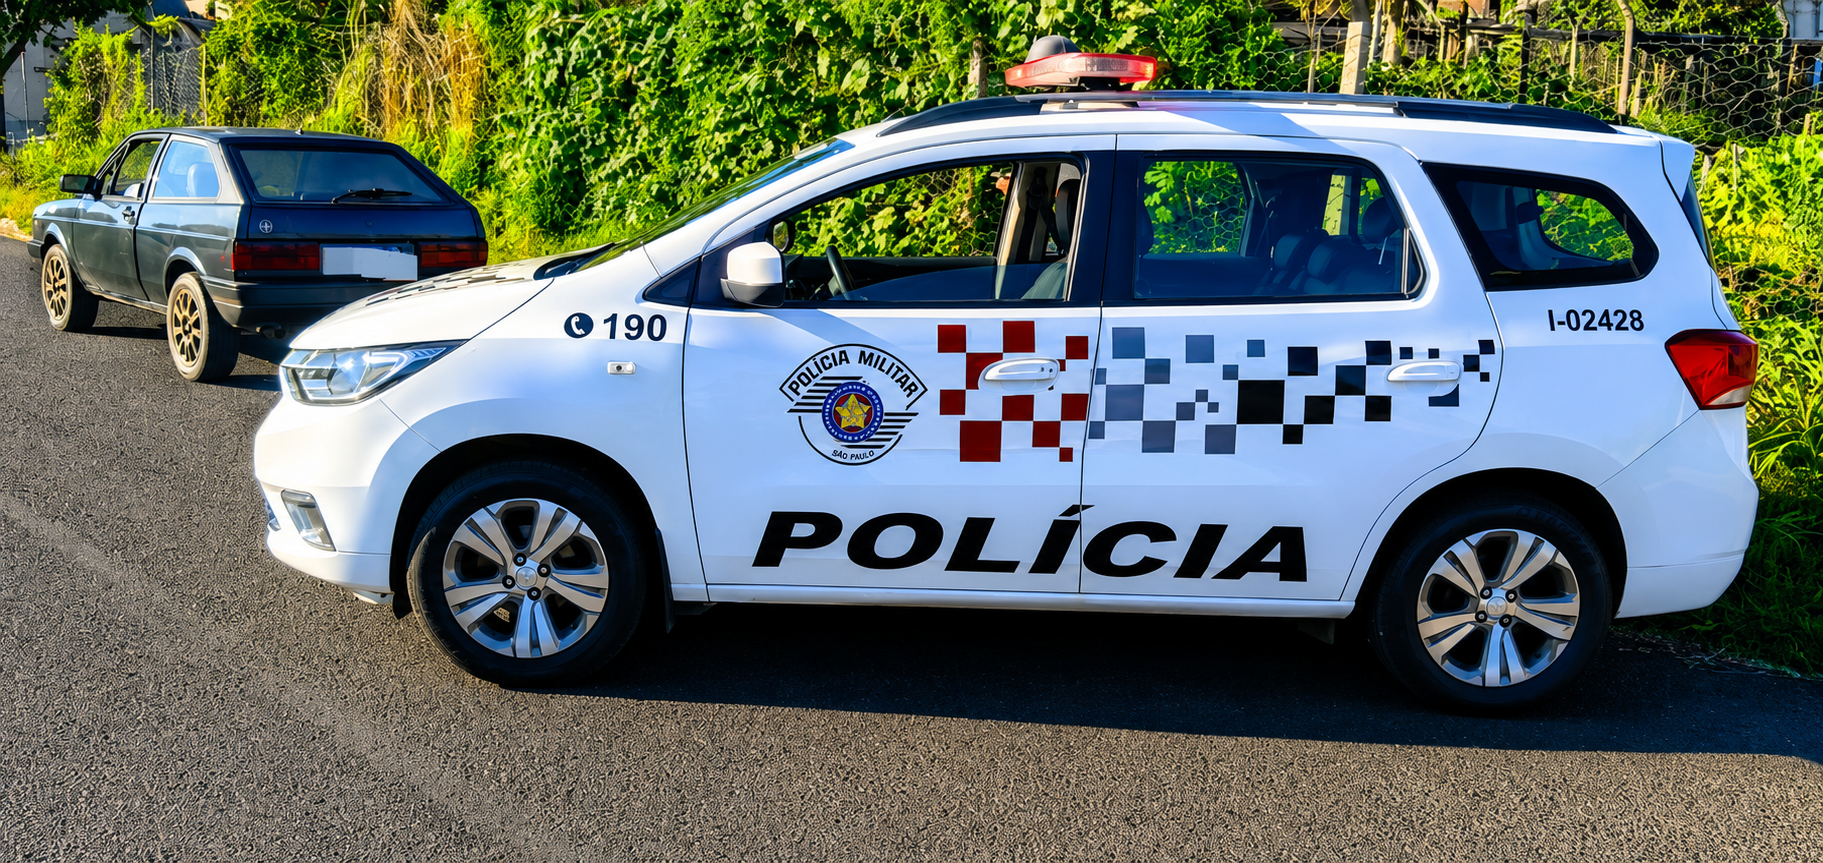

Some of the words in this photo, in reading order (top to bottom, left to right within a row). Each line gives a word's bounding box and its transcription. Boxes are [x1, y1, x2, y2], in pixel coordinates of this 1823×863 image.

[603, 313, 667, 341] 190
[1547, 308, 1644, 332] I-02428
[787, 350, 850, 396] POLÍCIA
[858, 350, 919, 398] MILITAR
[850, 450, 875, 460] PAULO
[751, 504, 1308, 582] POLÍCIA
